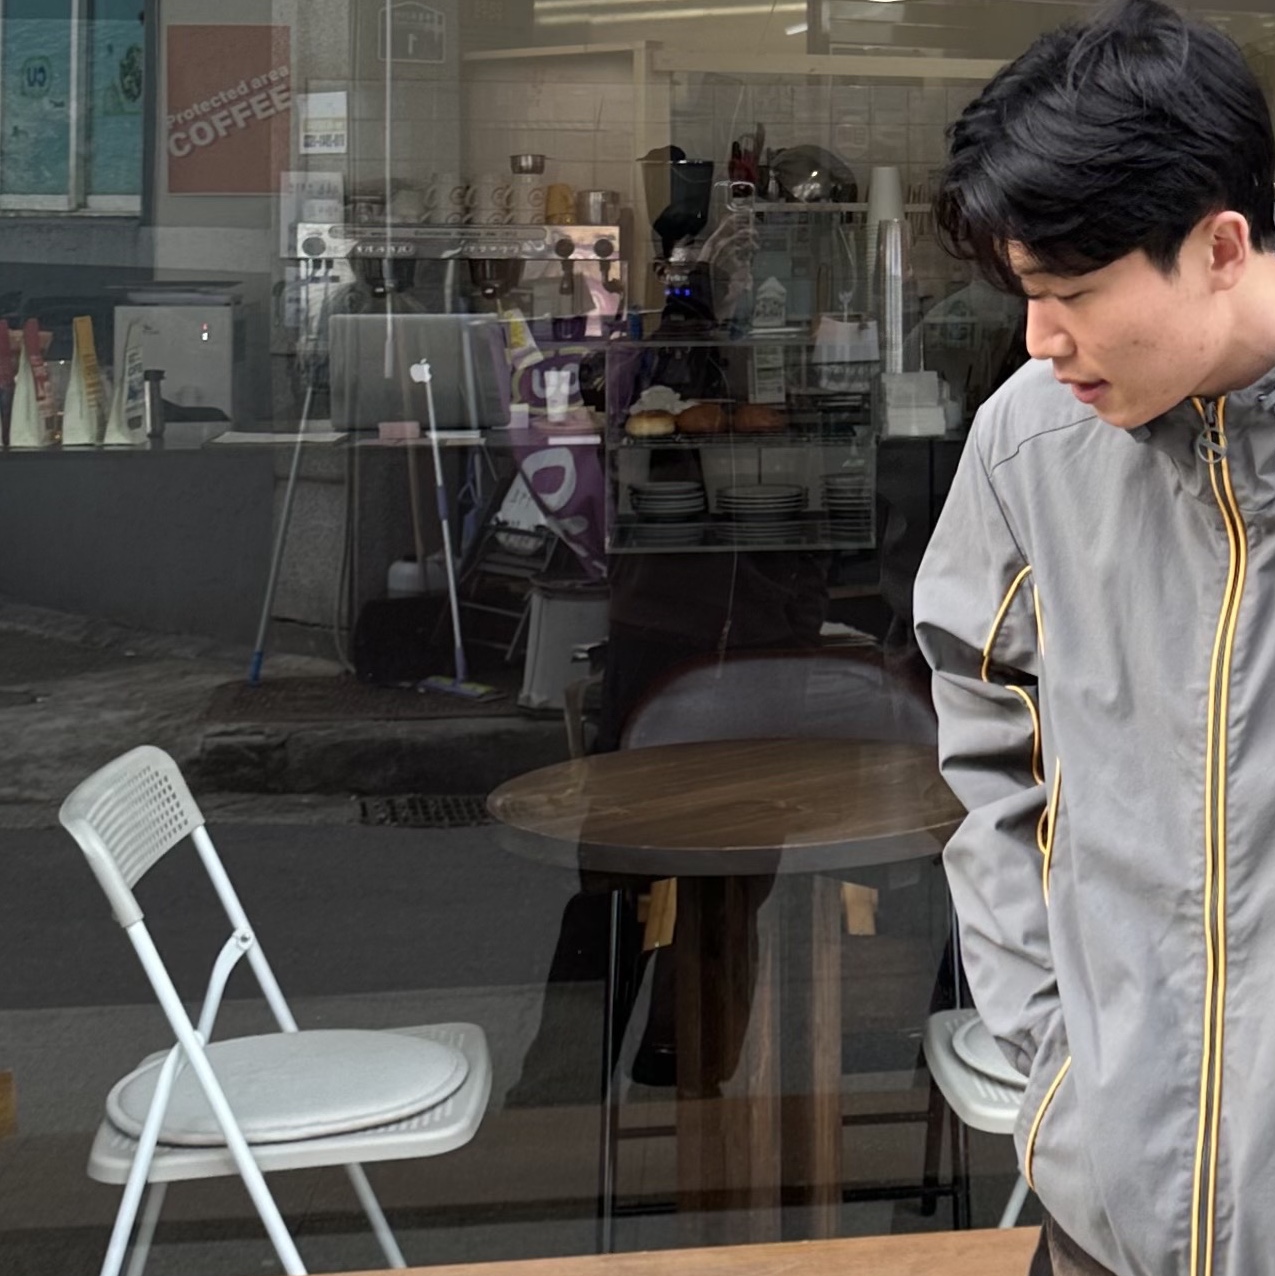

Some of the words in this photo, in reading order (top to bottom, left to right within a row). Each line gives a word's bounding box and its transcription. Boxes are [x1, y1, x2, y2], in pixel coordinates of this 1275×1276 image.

[165, 80, 249, 129] Protected
[252, 65, 290, 88] area
[168, 83, 292, 157] COFFEE
